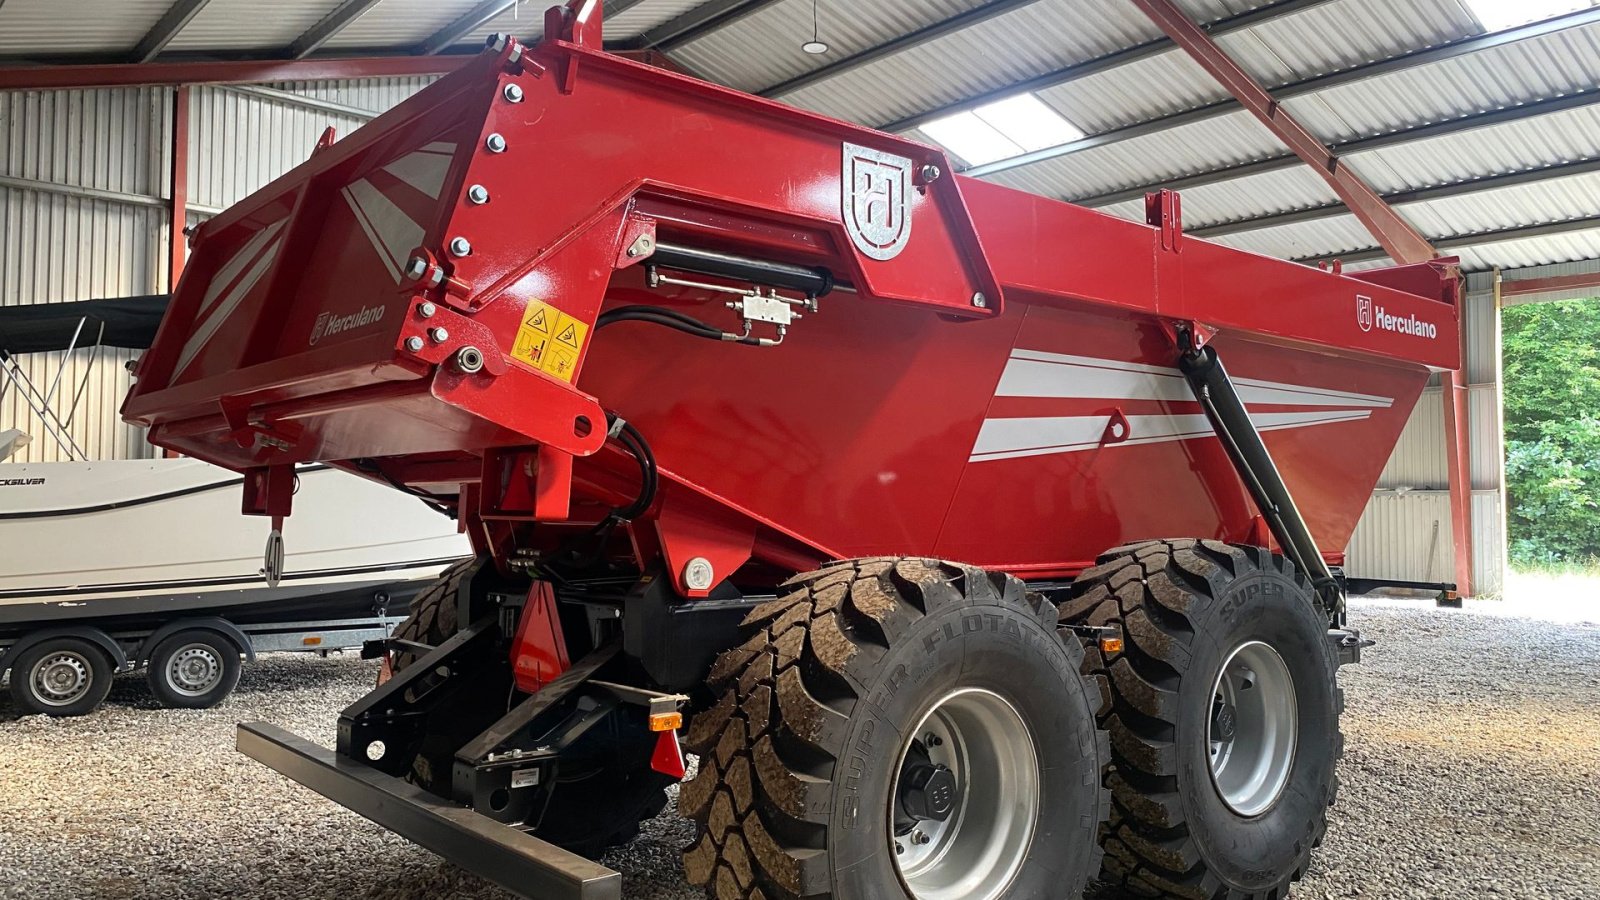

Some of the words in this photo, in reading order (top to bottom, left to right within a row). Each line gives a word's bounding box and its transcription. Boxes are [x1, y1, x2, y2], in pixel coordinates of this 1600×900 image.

[323, 304, 386, 337] Herculano
[1375, 305, 1437, 339] Herculano
[266, 537, 280, 580] 40
[1219, 582, 1284, 623] SUPER
[841, 663, 911, 830] SUPER
